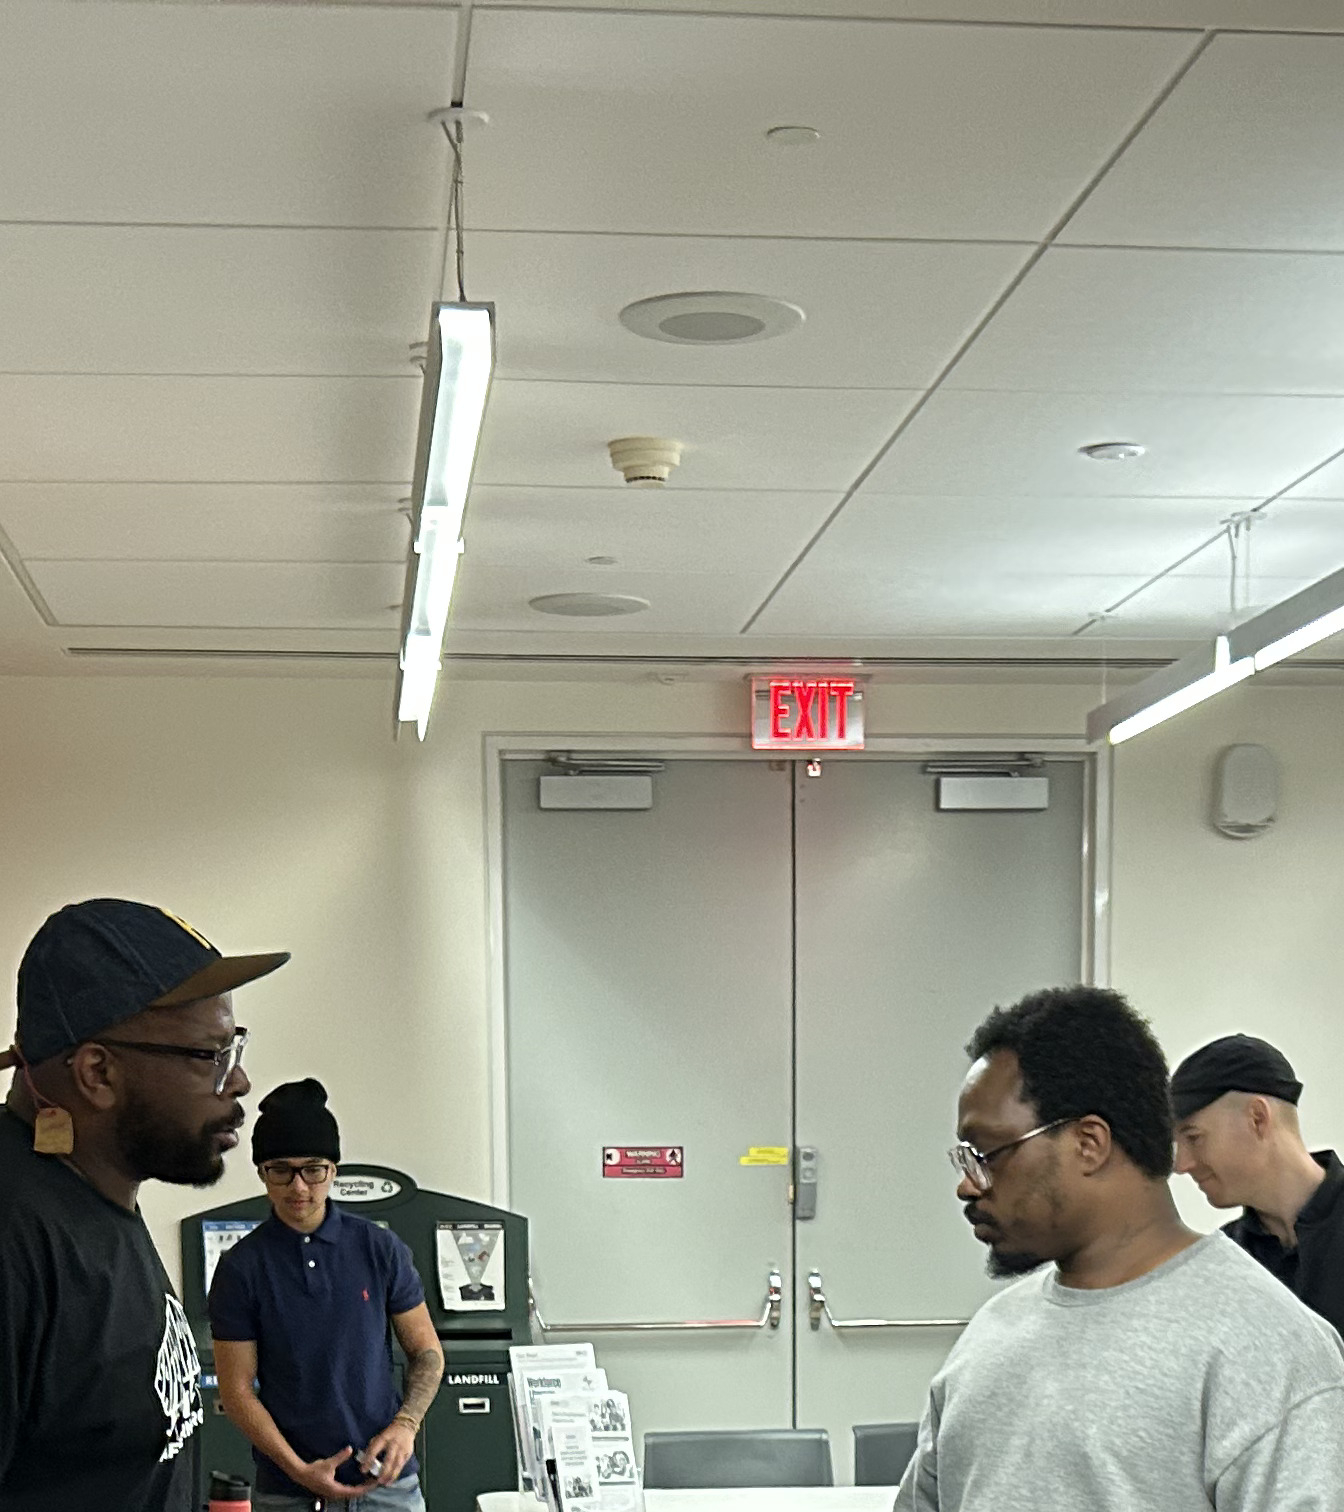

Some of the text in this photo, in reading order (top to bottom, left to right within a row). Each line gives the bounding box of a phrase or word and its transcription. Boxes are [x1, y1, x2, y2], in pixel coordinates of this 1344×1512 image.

[769, 680, 855, 741] EXIT
[333, 1180, 375, 1190] Recycling
[340, 1188, 368, 1196] Center
[448, 1374, 500, 1386] LANDFILL
